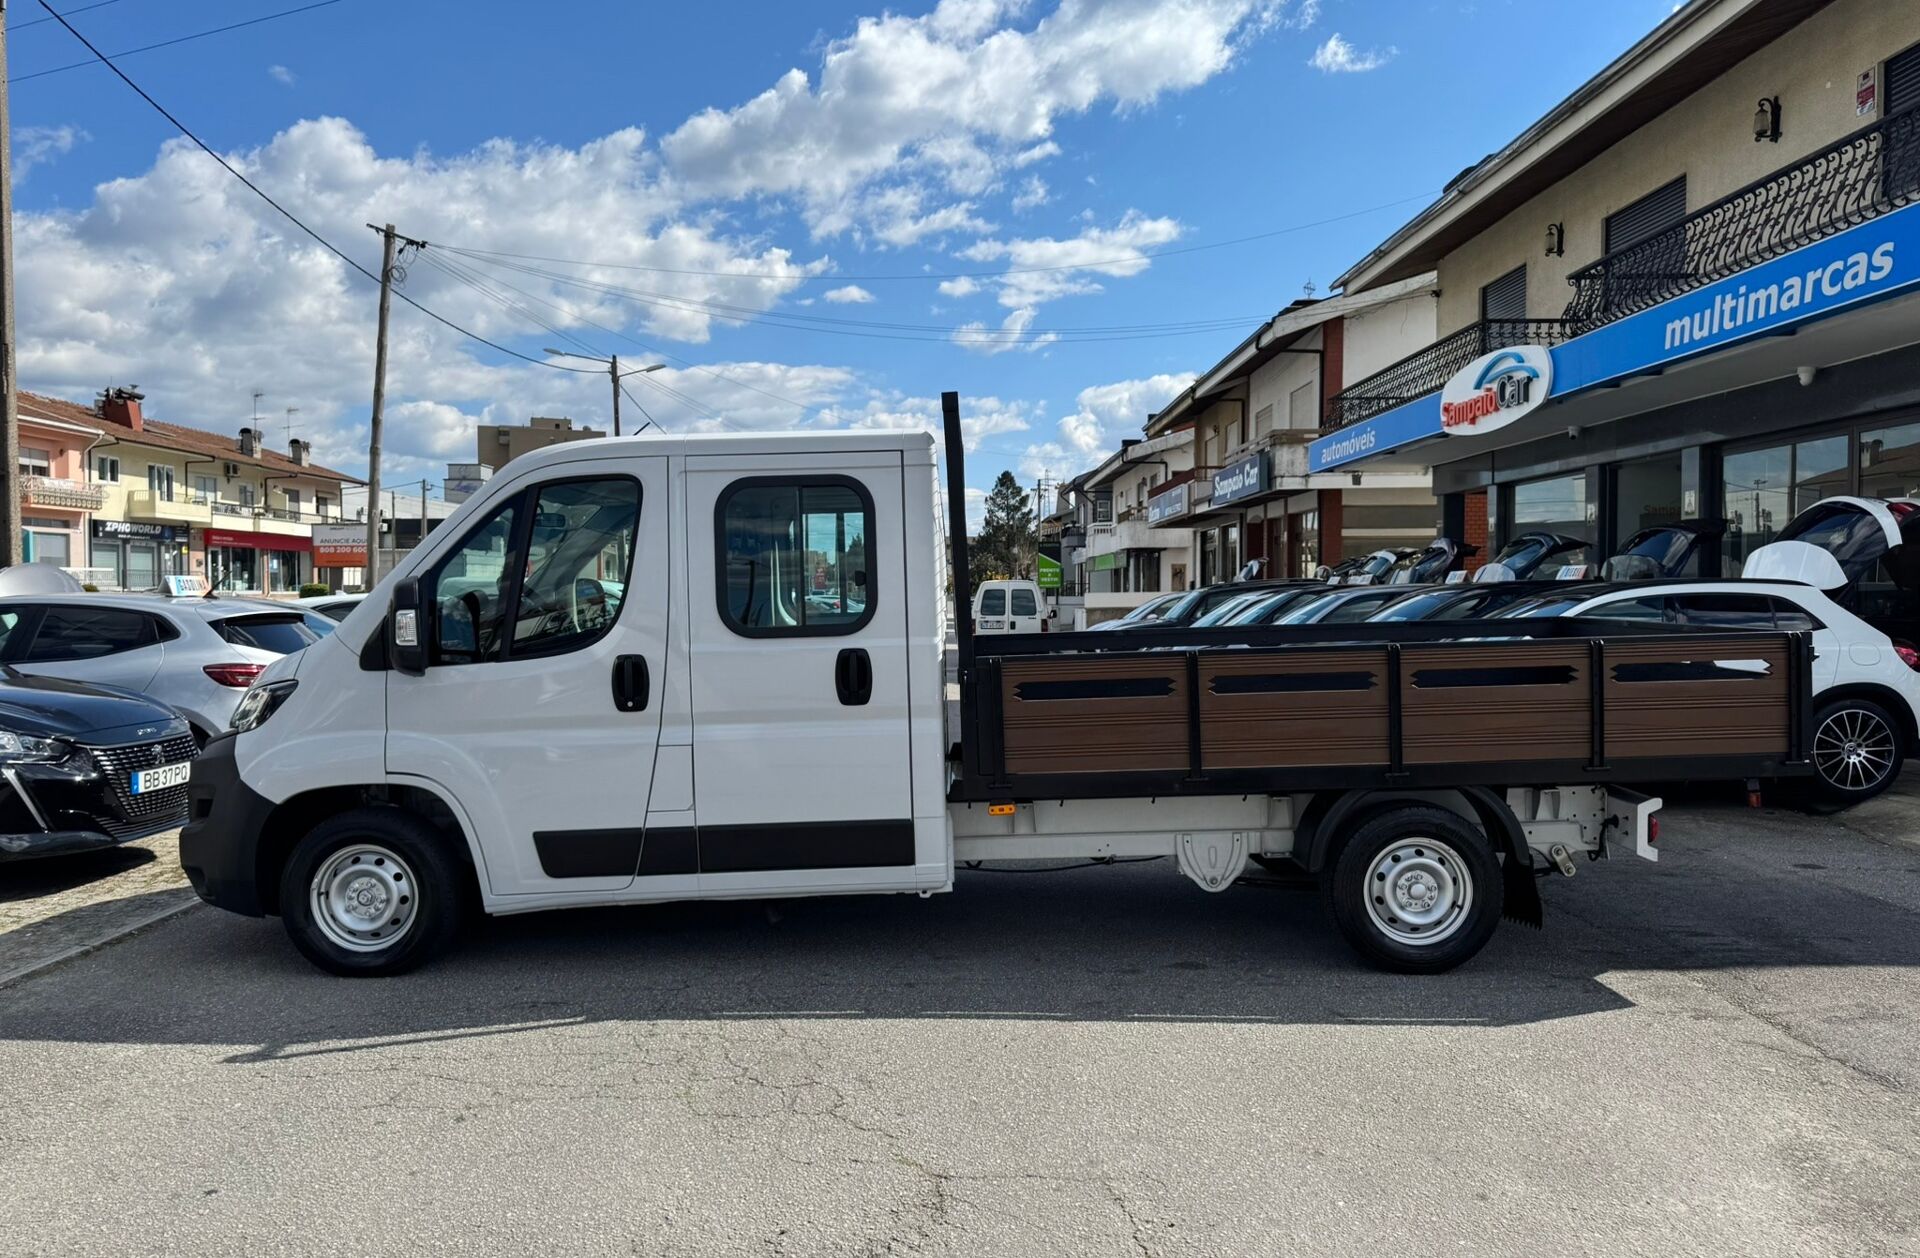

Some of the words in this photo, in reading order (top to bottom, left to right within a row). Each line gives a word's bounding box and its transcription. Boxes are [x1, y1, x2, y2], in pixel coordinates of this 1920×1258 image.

[1664, 241, 1895, 350] multimarcas
[1321, 427, 1376, 464] automóveis
[1214, 468, 1243, 499] Sampaio
[1244, 463, 1258, 487] Car
